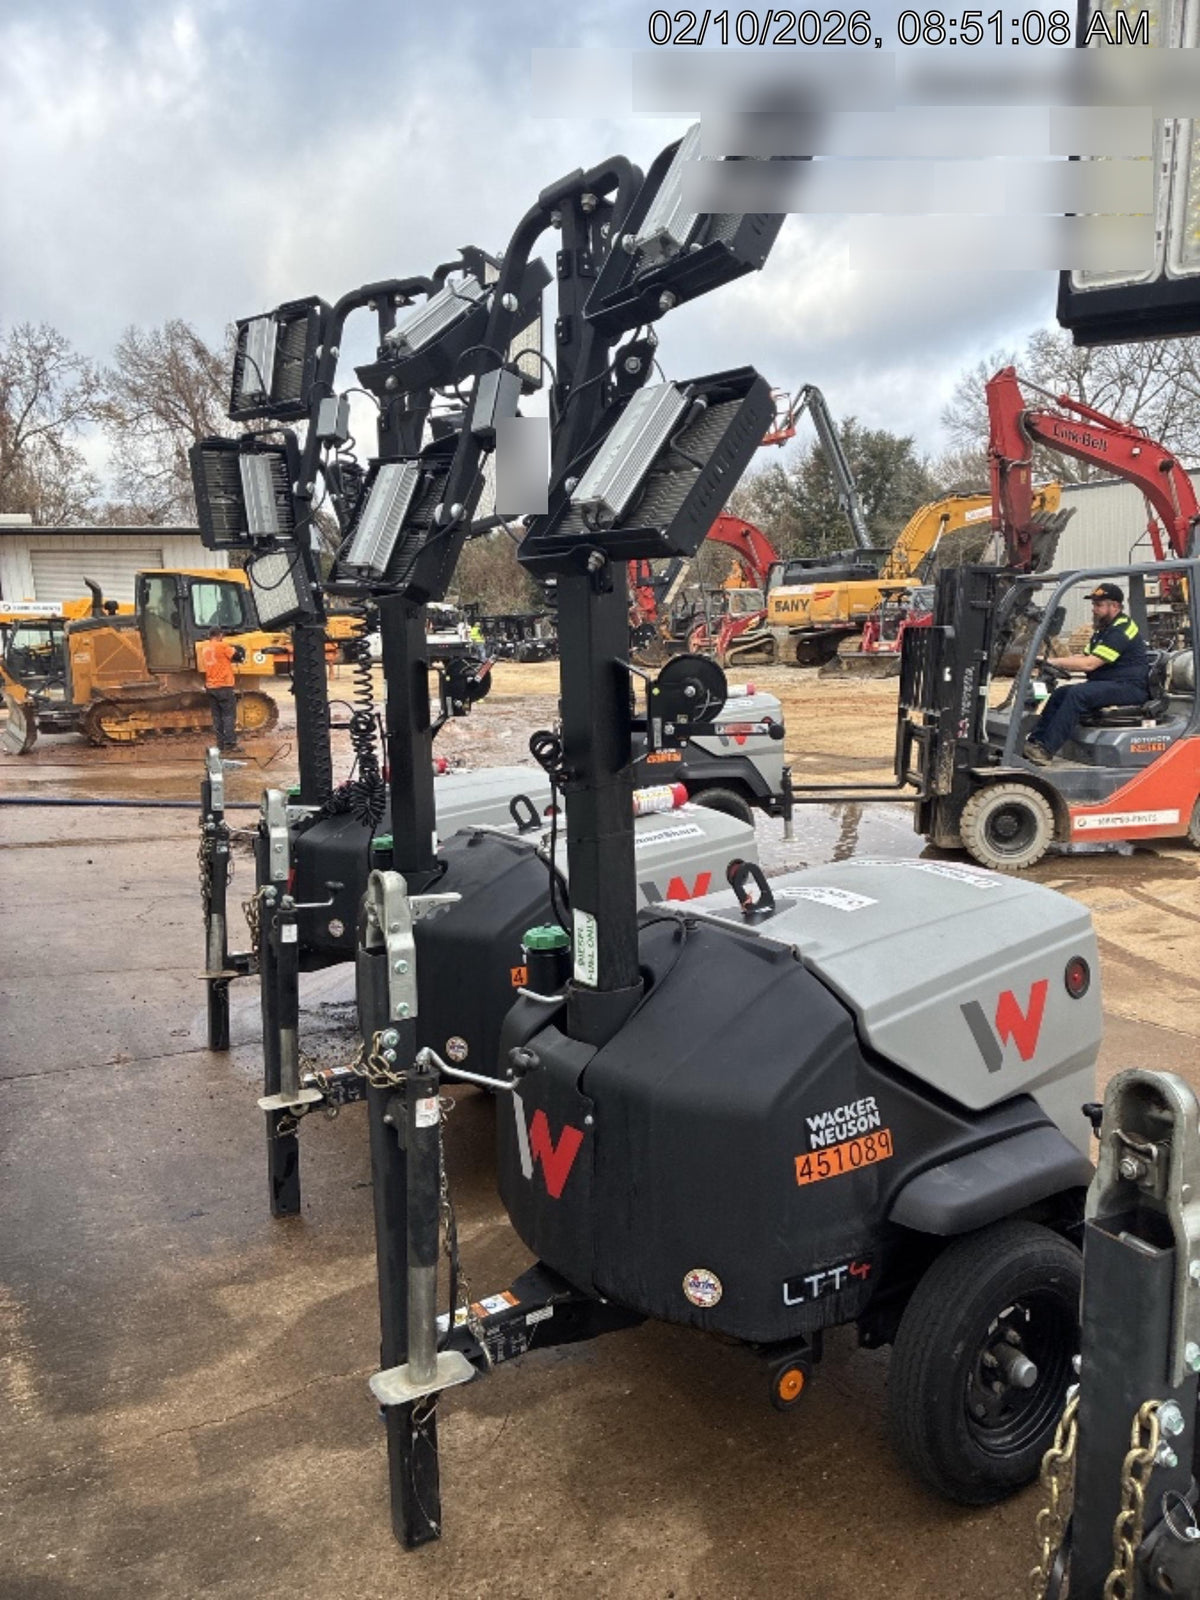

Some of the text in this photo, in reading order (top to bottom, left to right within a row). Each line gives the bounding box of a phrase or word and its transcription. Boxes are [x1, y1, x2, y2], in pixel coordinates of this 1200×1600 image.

[775, 598, 810, 613] SANY
[805, 1096, 879, 1132] WACKER
[810, 1111, 881, 1149] NEUSON
[799, 1131, 891, 1180] 451089
